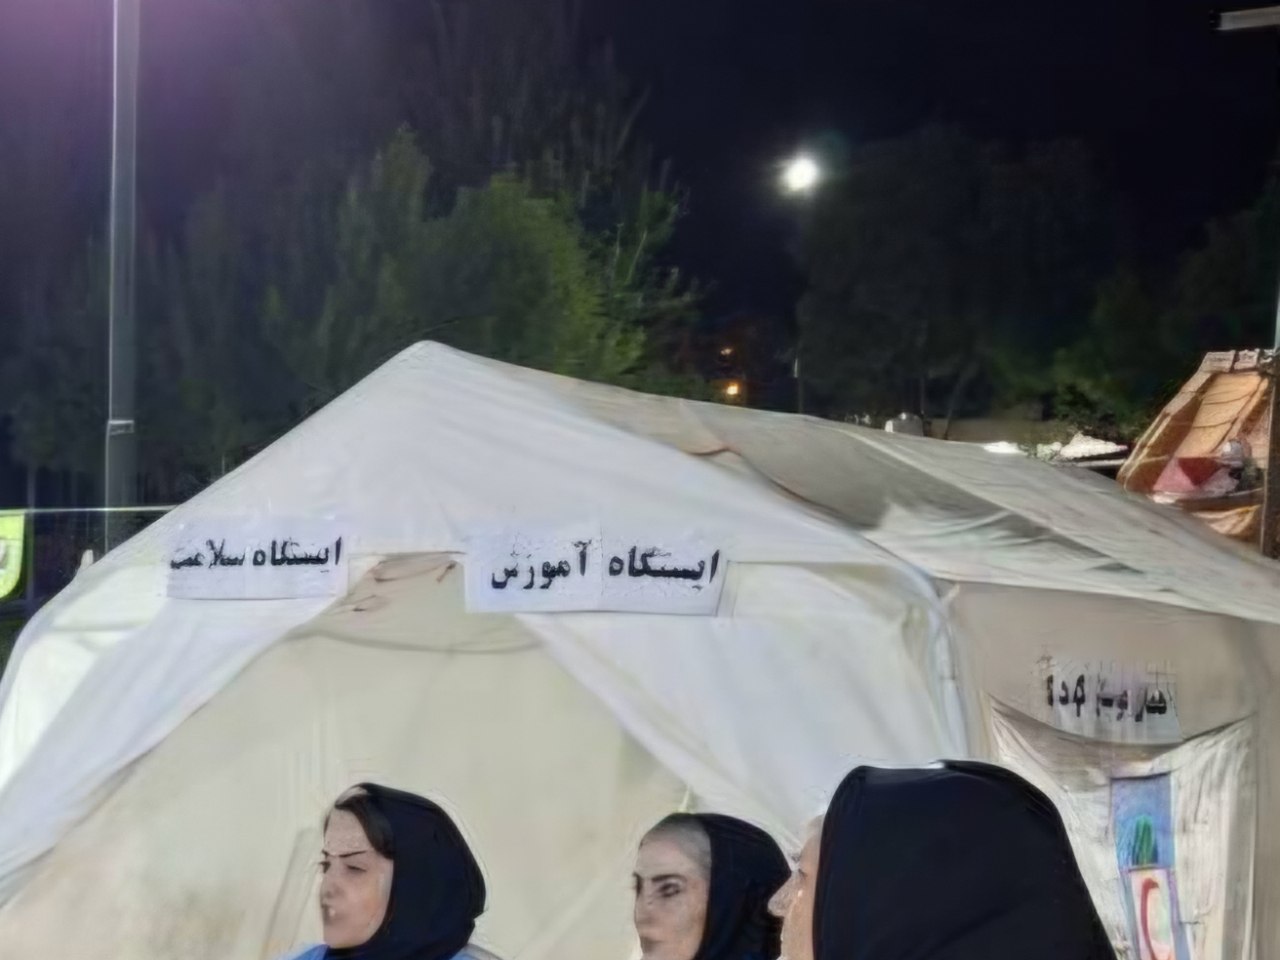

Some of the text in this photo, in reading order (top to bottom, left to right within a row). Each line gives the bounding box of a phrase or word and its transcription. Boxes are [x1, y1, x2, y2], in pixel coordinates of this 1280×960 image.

[252, 536, 342, 573] ایستگاه
[491, 538, 720, 591] ایستگاه آموزش
